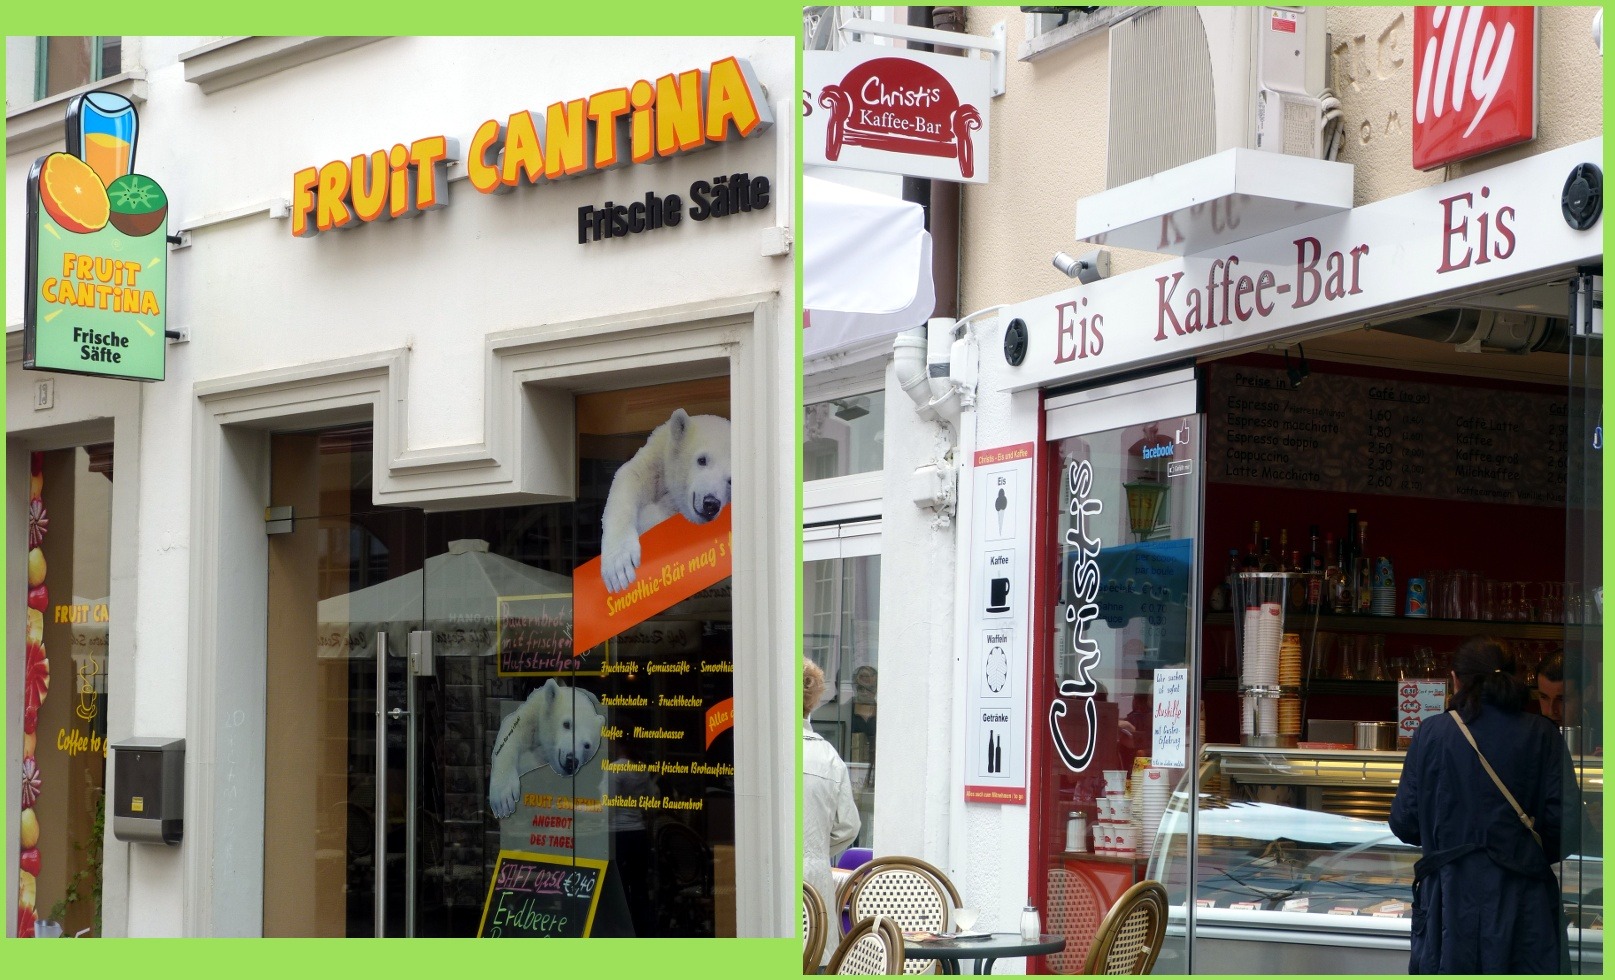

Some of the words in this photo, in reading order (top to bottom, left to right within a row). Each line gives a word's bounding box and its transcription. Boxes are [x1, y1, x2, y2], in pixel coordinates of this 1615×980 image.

[1415, 6, 1515, 138] illy
[861, 76, 940, 108] Christis
[860, 109, 941, 134] Kaffee-Bar
[577, 191, 682, 244] Frische
[689, 172, 770, 222] Säfte
[1054, 297, 1104, 365] Eis
[1154, 236, 1370, 342] Kaffee-Bar
[1436, 186, 1517, 275] Eis
[73, 328, 129, 348] Frische
[80, 346, 122, 364] Säfte
[1235, 373, 1270, 387] Preise
[1276, 379, 1286, 388] in
[1368, 387, 1394, 400] Café
[1228, 396, 1279, 412] Espresso
[1368, 409, 1392, 422] 1,60
[1228, 412, 1279, 428] Espresso
[1283, 420, 1339, 434] macchiato
[1368, 426, 1392, 438] 1,80
[1491, 420, 1520, 432] Latte
[1227, 430, 1278, 446] Espresso
[1283, 434, 1319, 452] doppio
[1368, 442, 1392, 455] 2,50
[1456, 434, 1492, 446] Kaffee
[1005, 451, 1014, 460] und
[1014, 450, 1028, 458] Kaffee
[1143, 441, 1174, 460] facebook
[1226, 447, 1289, 463] Cappuccino
[1368, 458, 1392, 471] 2,30
[1456, 449, 1490, 462] Kaffee
[1495, 450, 1519, 466] groß
[998, 476, 1006, 486] Eis
[1226, 464, 1257, 478] Latte
[1262, 467, 1320, 482] Macchiato
[1368, 474, 1392, 488] 2,60
[1455, 466, 1520, 480] Milchkaffee
[990, 556, 1008, 566] Kaffee
[606, 562, 685, 617] Smoothie-Bär
[502, 602, 566, 628] Bauernbrot
[1049, 459, 1103, 772] Christis
[502, 631, 524, 648] mit
[526, 630, 572, 656] frischen
[986, 634, 1008, 644] Waffeln
[600, 661, 639, 674] Fruchtsäfte
[646, 660, 690, 676] Gemüsesäfte
[601, 694, 648, 706] Fruchtschalen
[658, 694, 703, 707] Fruchtbecher
[708, 710, 729, 732] Alles
[982, 712, 1008, 723] Getränke
[1154, 700, 1182, 726] Aushilfe
[58, 728, 89, 757] Coffee
[90, 730, 101, 752] to
[601, 726, 623, 740] Kaffee
[634, 726, 684, 740] Mineralwasser
[601, 759, 646, 774] Klappschmier
[648, 762, 660, 773] mit
[661, 760, 688, 776] frischen
[602, 794, 637, 808] Rustikales
[638, 796, 660, 811] Eifeler
[662, 796, 704, 811] Bauernbrot
[532, 814, 573, 830] ANGEBOT
[529, 834, 546, 846] DES
[548, 836, 576, 850] TAGES
[494, 891, 568, 932] Erdbeere
